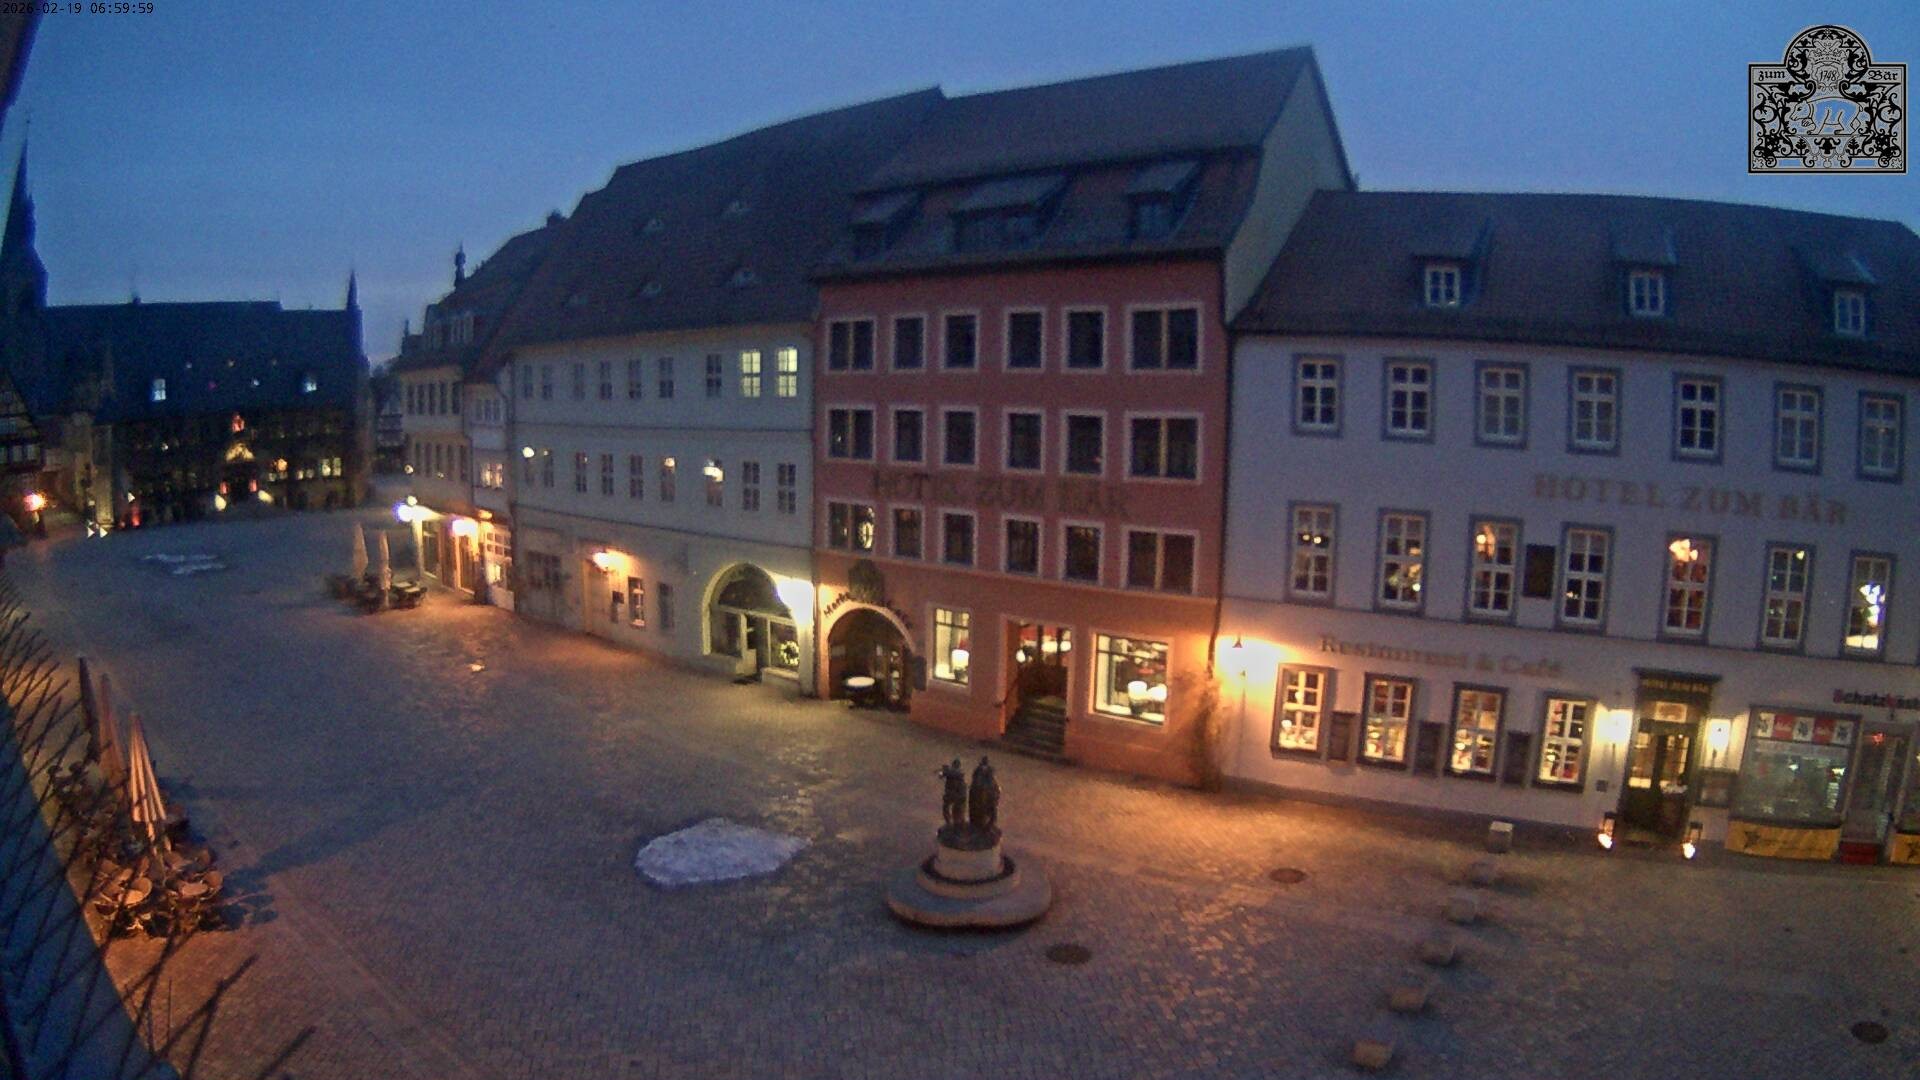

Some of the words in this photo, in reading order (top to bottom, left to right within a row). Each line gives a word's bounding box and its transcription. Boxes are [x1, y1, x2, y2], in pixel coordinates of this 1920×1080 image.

[1534, 473, 1666, 509] HOTEL
[1679, 485, 1763, 518] ZUM
[1778, 489, 1848, 525] BÄR
[1320, 633, 1469, 669] Restaurant
